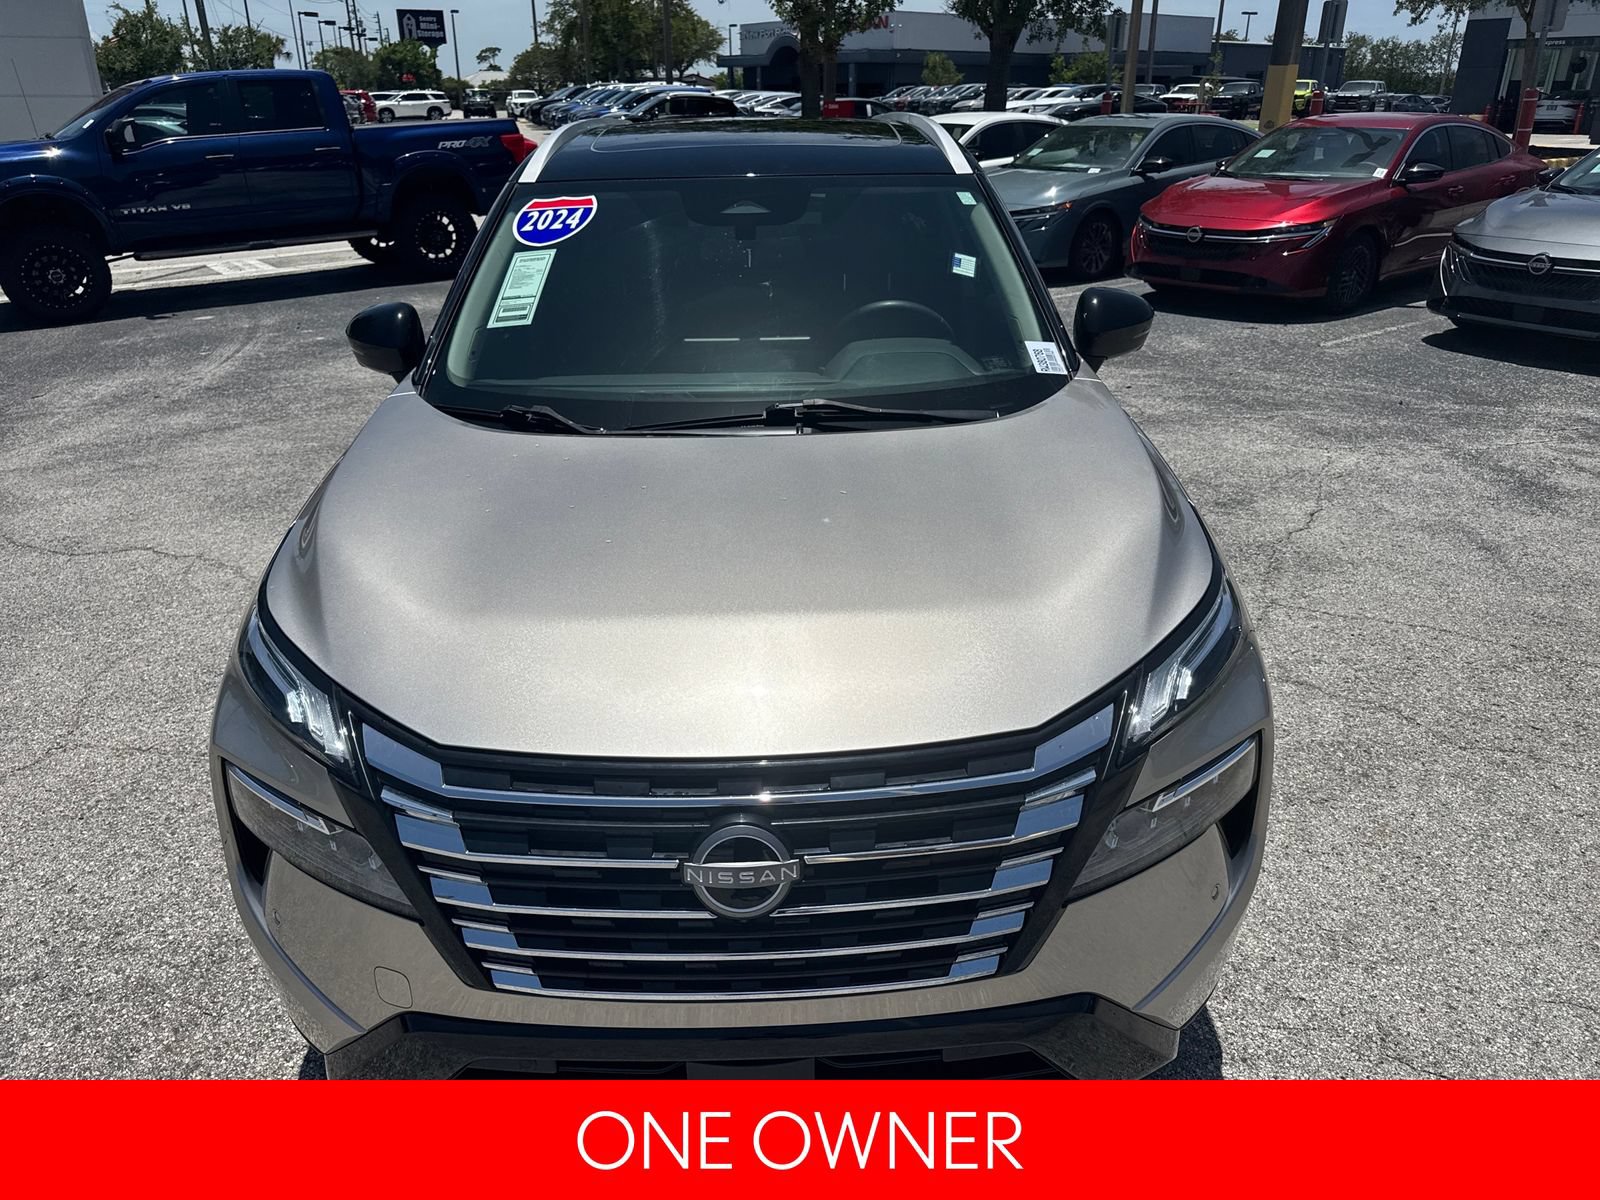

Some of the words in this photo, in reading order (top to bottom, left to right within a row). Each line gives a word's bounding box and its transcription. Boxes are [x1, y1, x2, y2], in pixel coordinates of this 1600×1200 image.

[120, 206, 167, 215] TITAN
[520, 208, 584, 232] 2024
[687, 865, 797, 884] NISSAN
